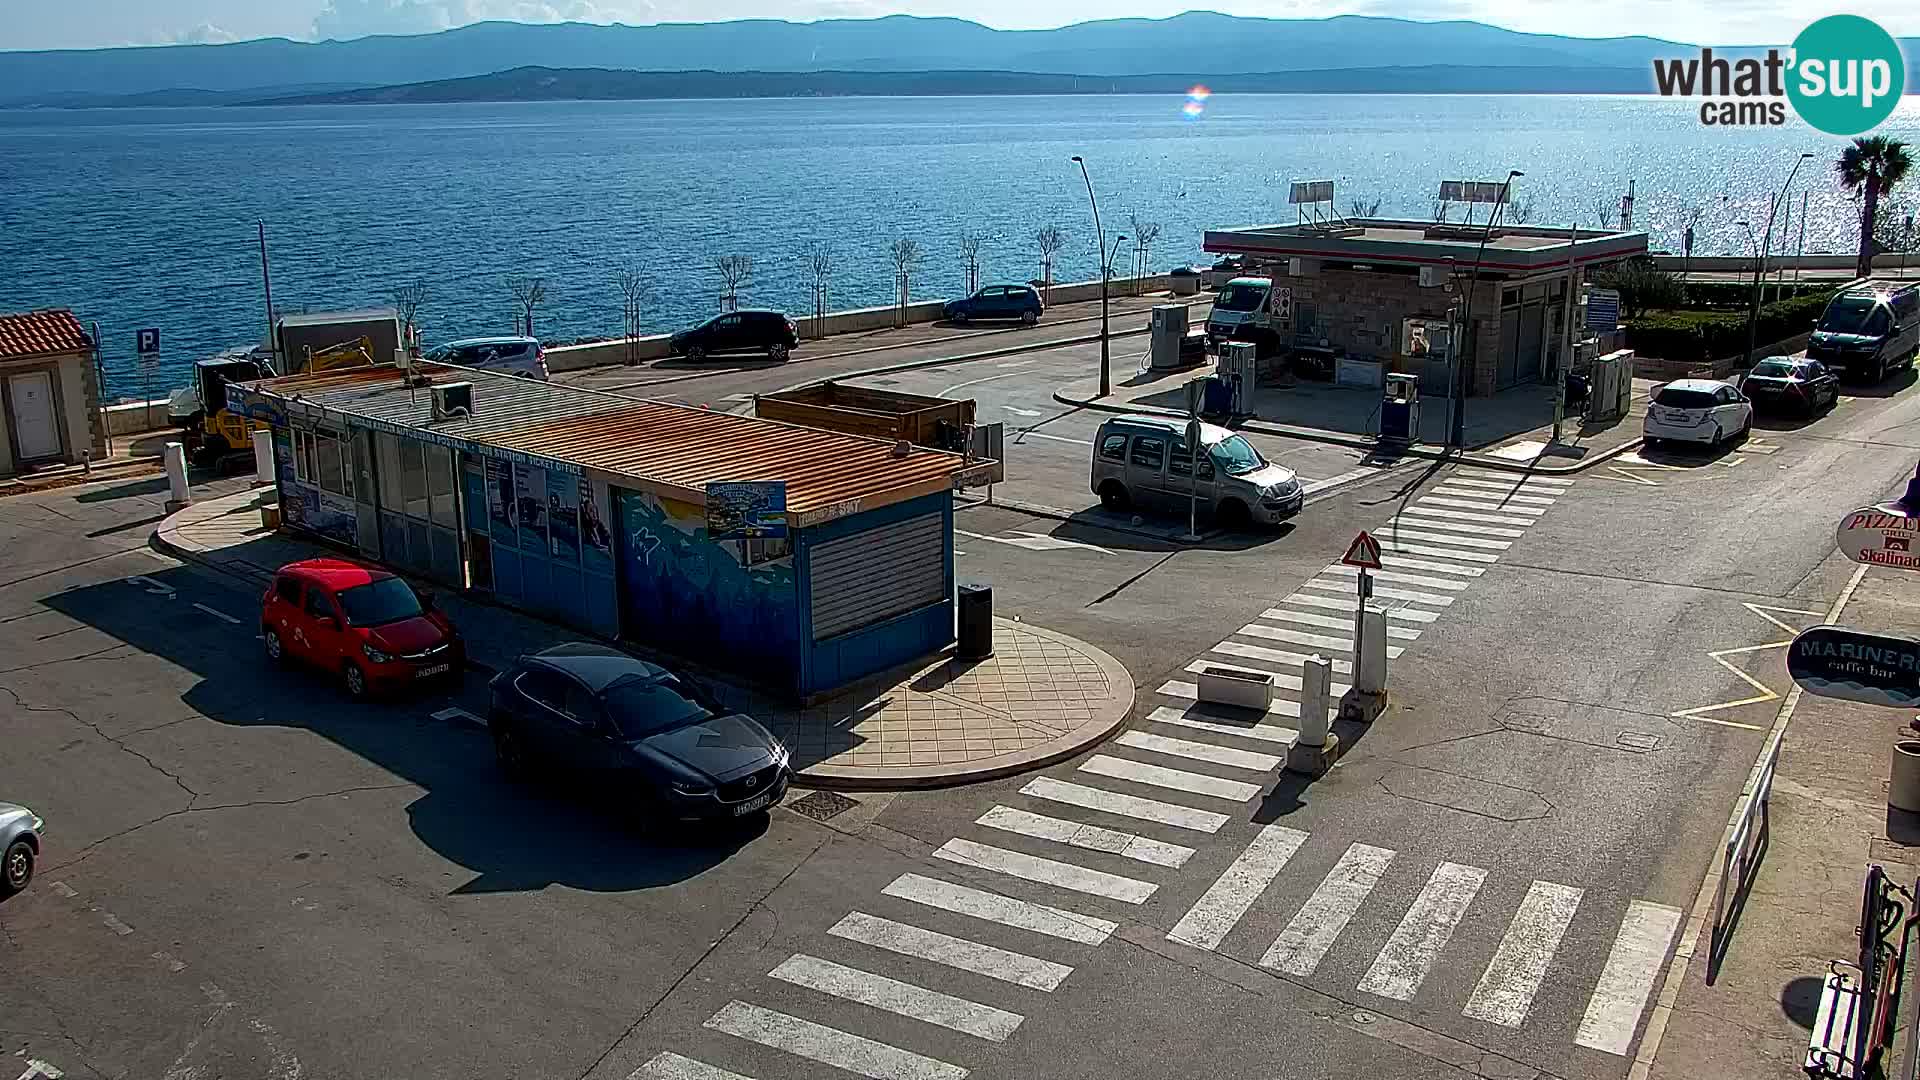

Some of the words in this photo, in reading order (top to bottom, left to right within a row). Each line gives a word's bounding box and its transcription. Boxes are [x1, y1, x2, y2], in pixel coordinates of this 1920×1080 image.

[142, 331, 153, 350] P
[494, 447, 526, 464] STATION
[529, 455, 554, 470] TICKET
[556, 461, 583, 476] OFFICE
[1848, 514, 1920, 532] PIZZE
[1881, 529, 1916, 539] GRILL
[1828, 660, 1865, 673] caffe
[1870, 664, 1896, 679] bar
